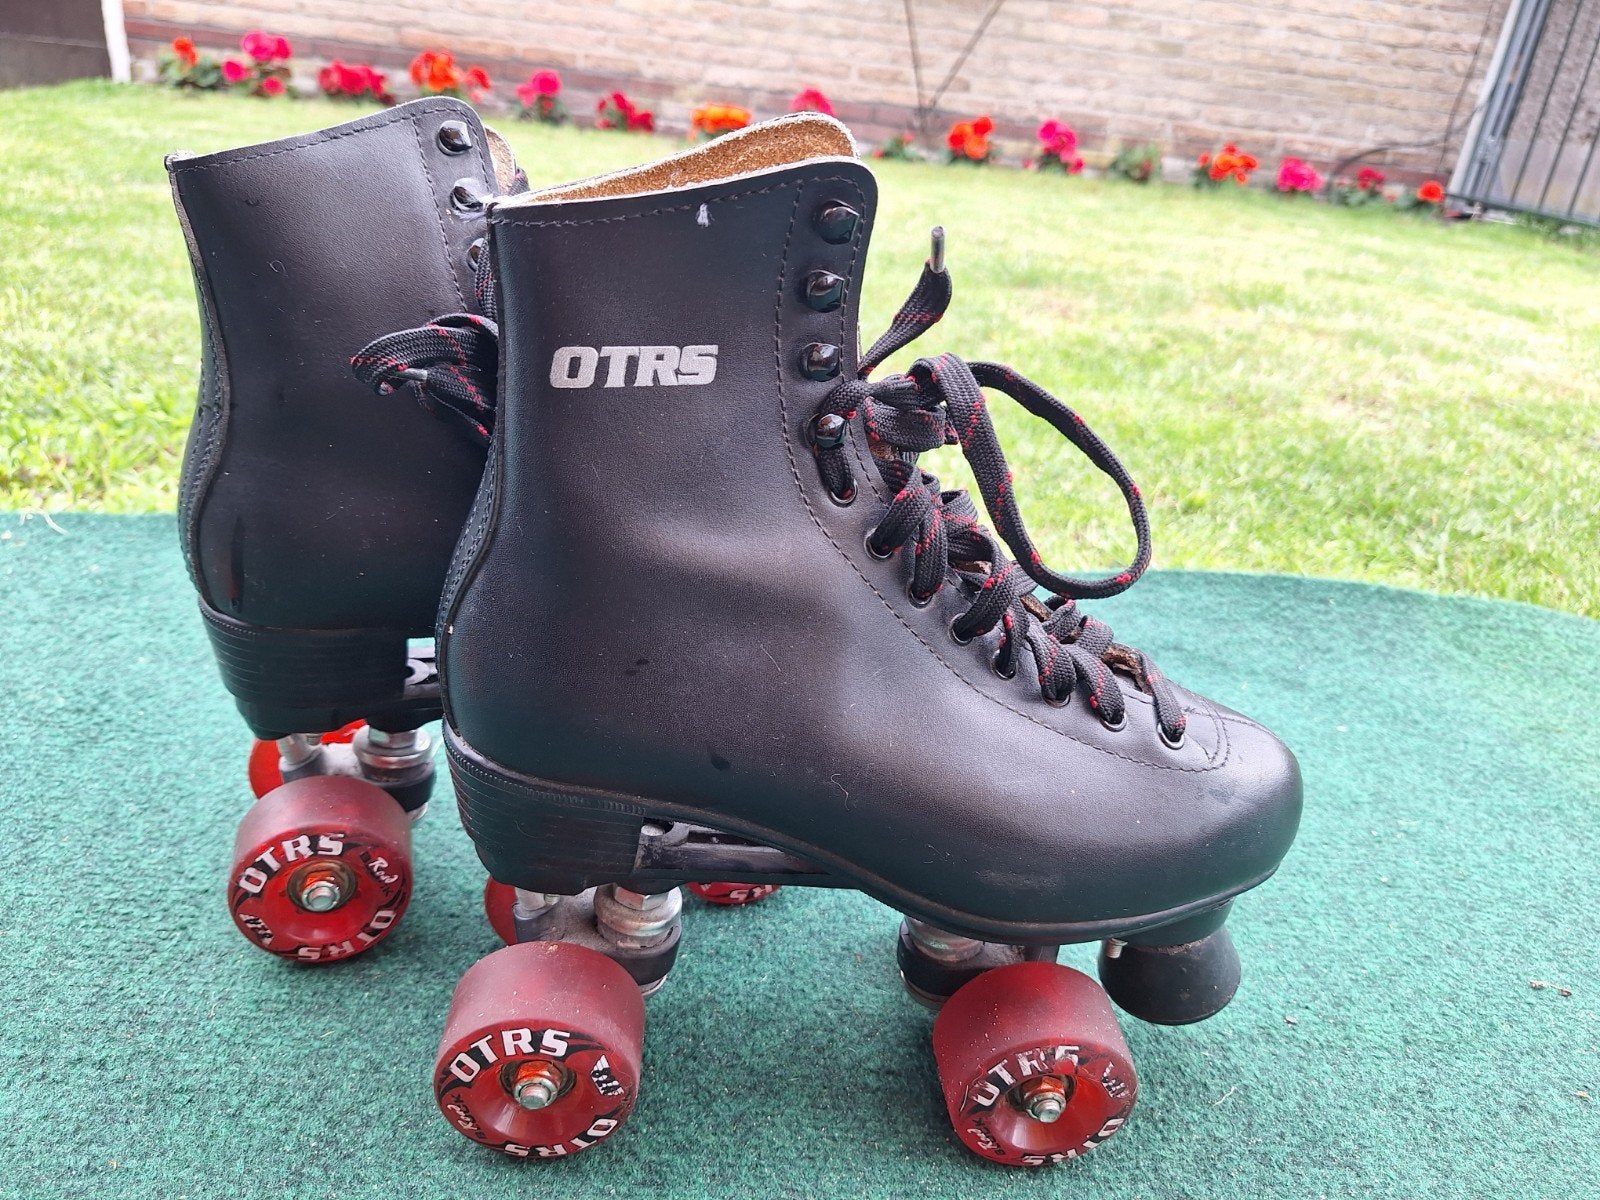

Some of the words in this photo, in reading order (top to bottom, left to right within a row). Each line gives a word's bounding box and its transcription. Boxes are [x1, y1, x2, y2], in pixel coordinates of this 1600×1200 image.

[549, 345, 719, 388] OTRS
[239, 833, 345, 894] OTRS
[297, 910, 396, 960] OTRS
[450, 1028, 570, 1083] OTRS
[504, 1118, 618, 1158] OTRS
